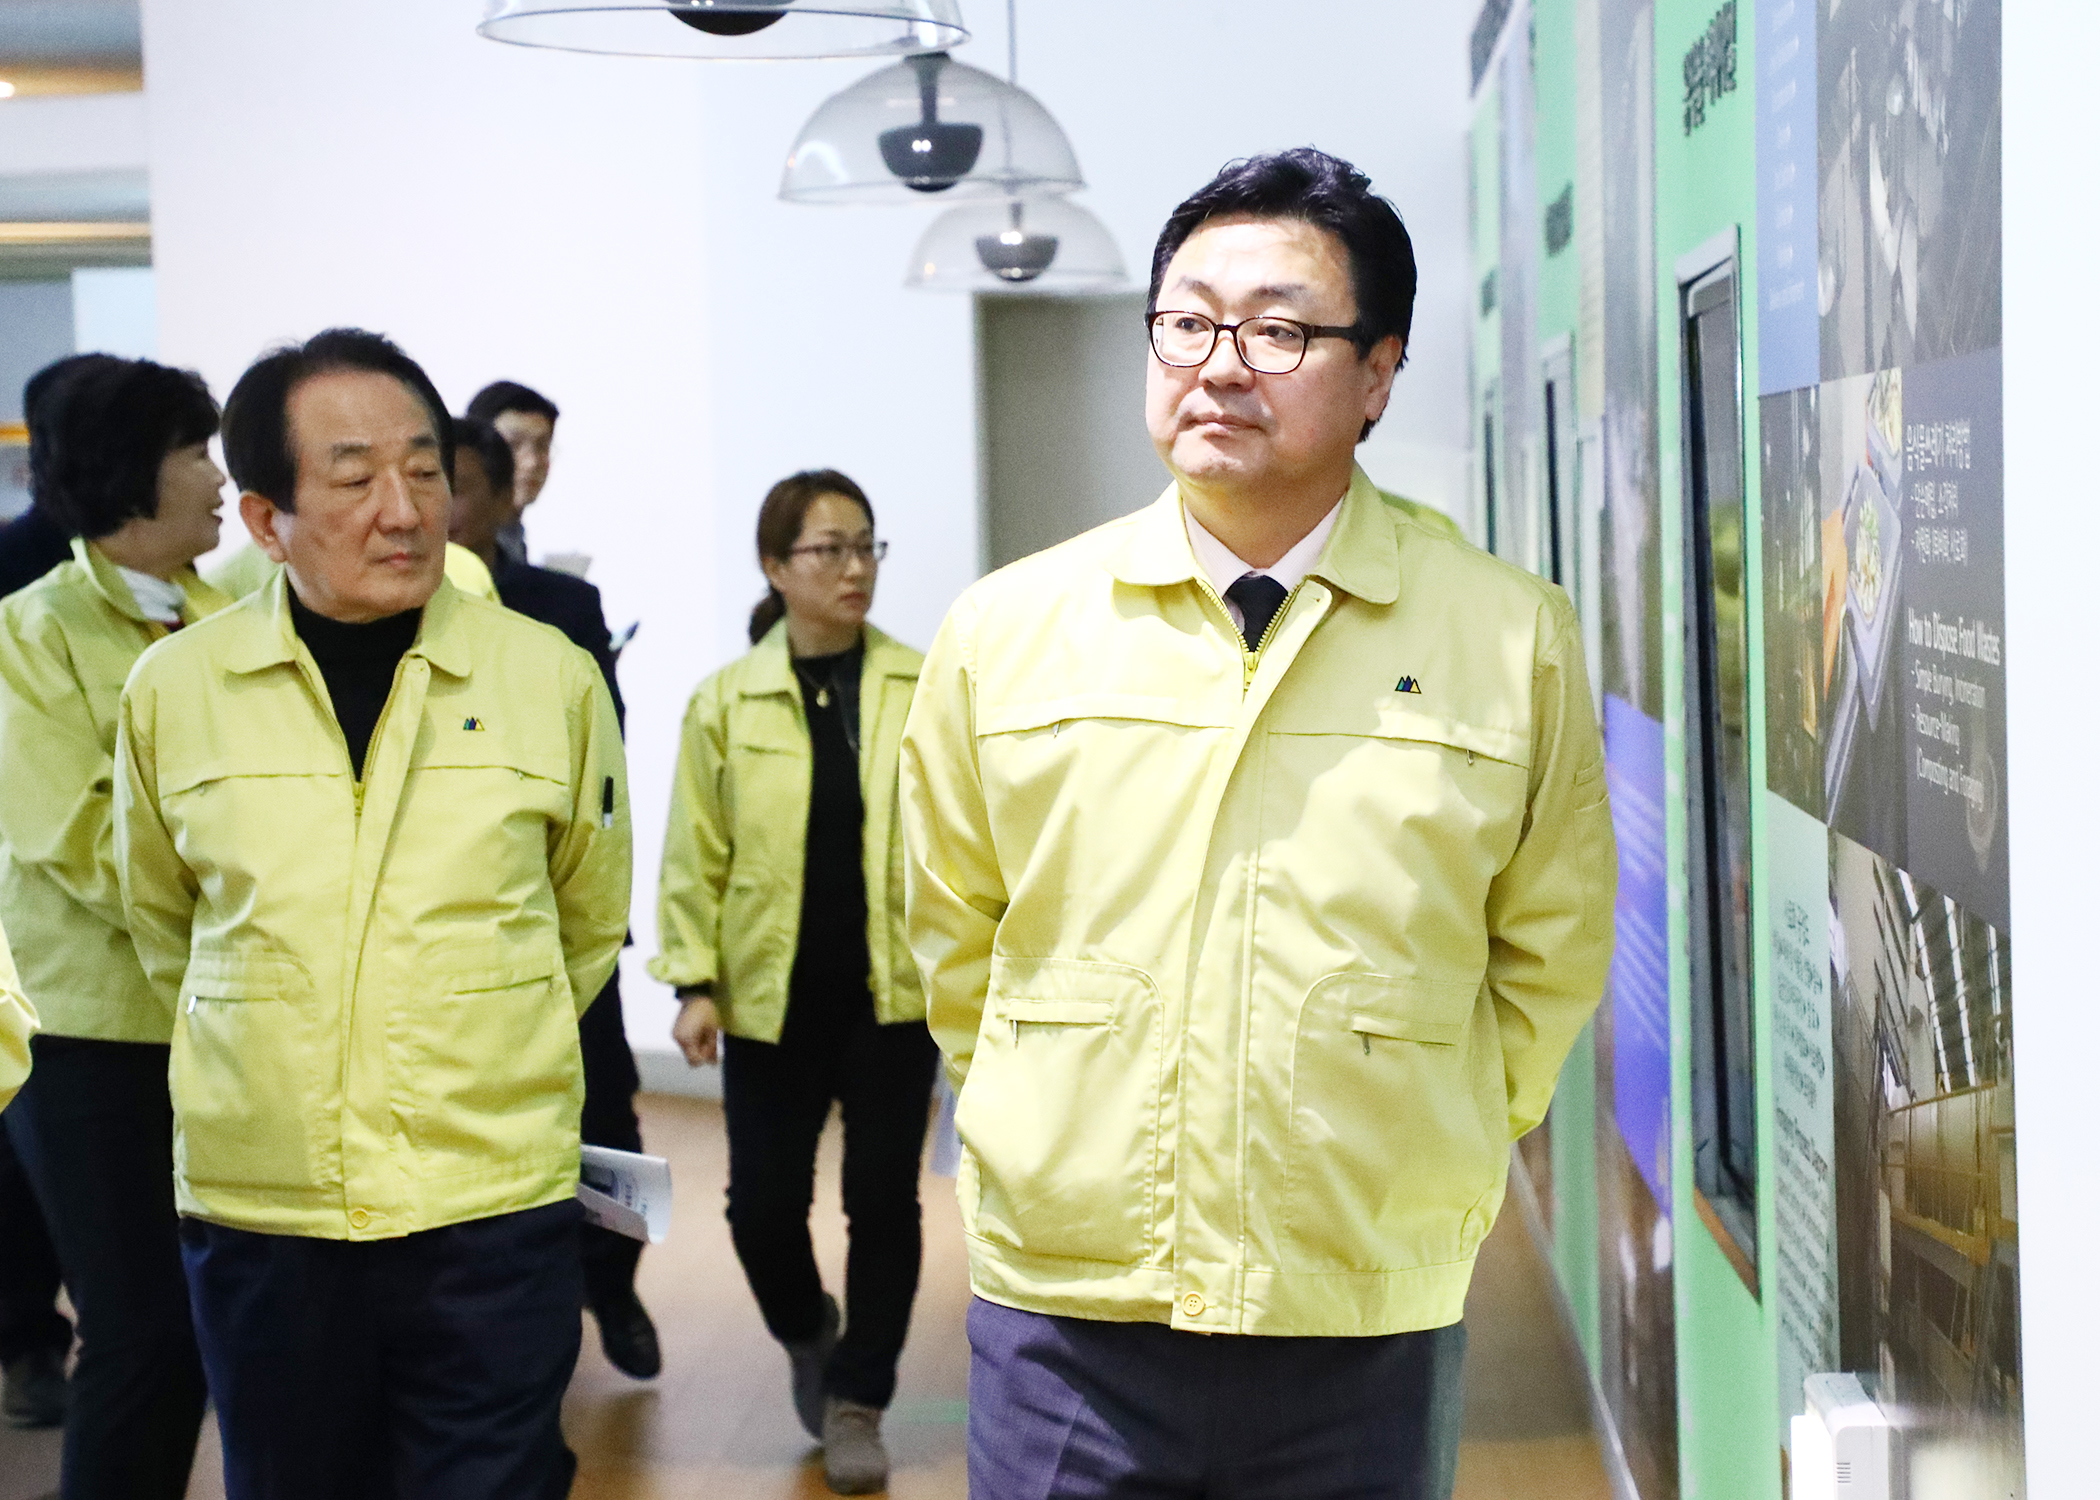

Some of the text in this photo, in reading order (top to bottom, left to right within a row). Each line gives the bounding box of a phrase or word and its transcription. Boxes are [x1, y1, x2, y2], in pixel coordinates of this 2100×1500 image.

[1905, 418, 1970, 471] 음식물쓰레기 처리방법
[1908, 606, 2000, 666] How to Dispose Food Wastes
[1915, 658, 1932, 696] Simple
[1954, 670, 1986, 709] Incineration
[1949, 763, 1960, 794] and
